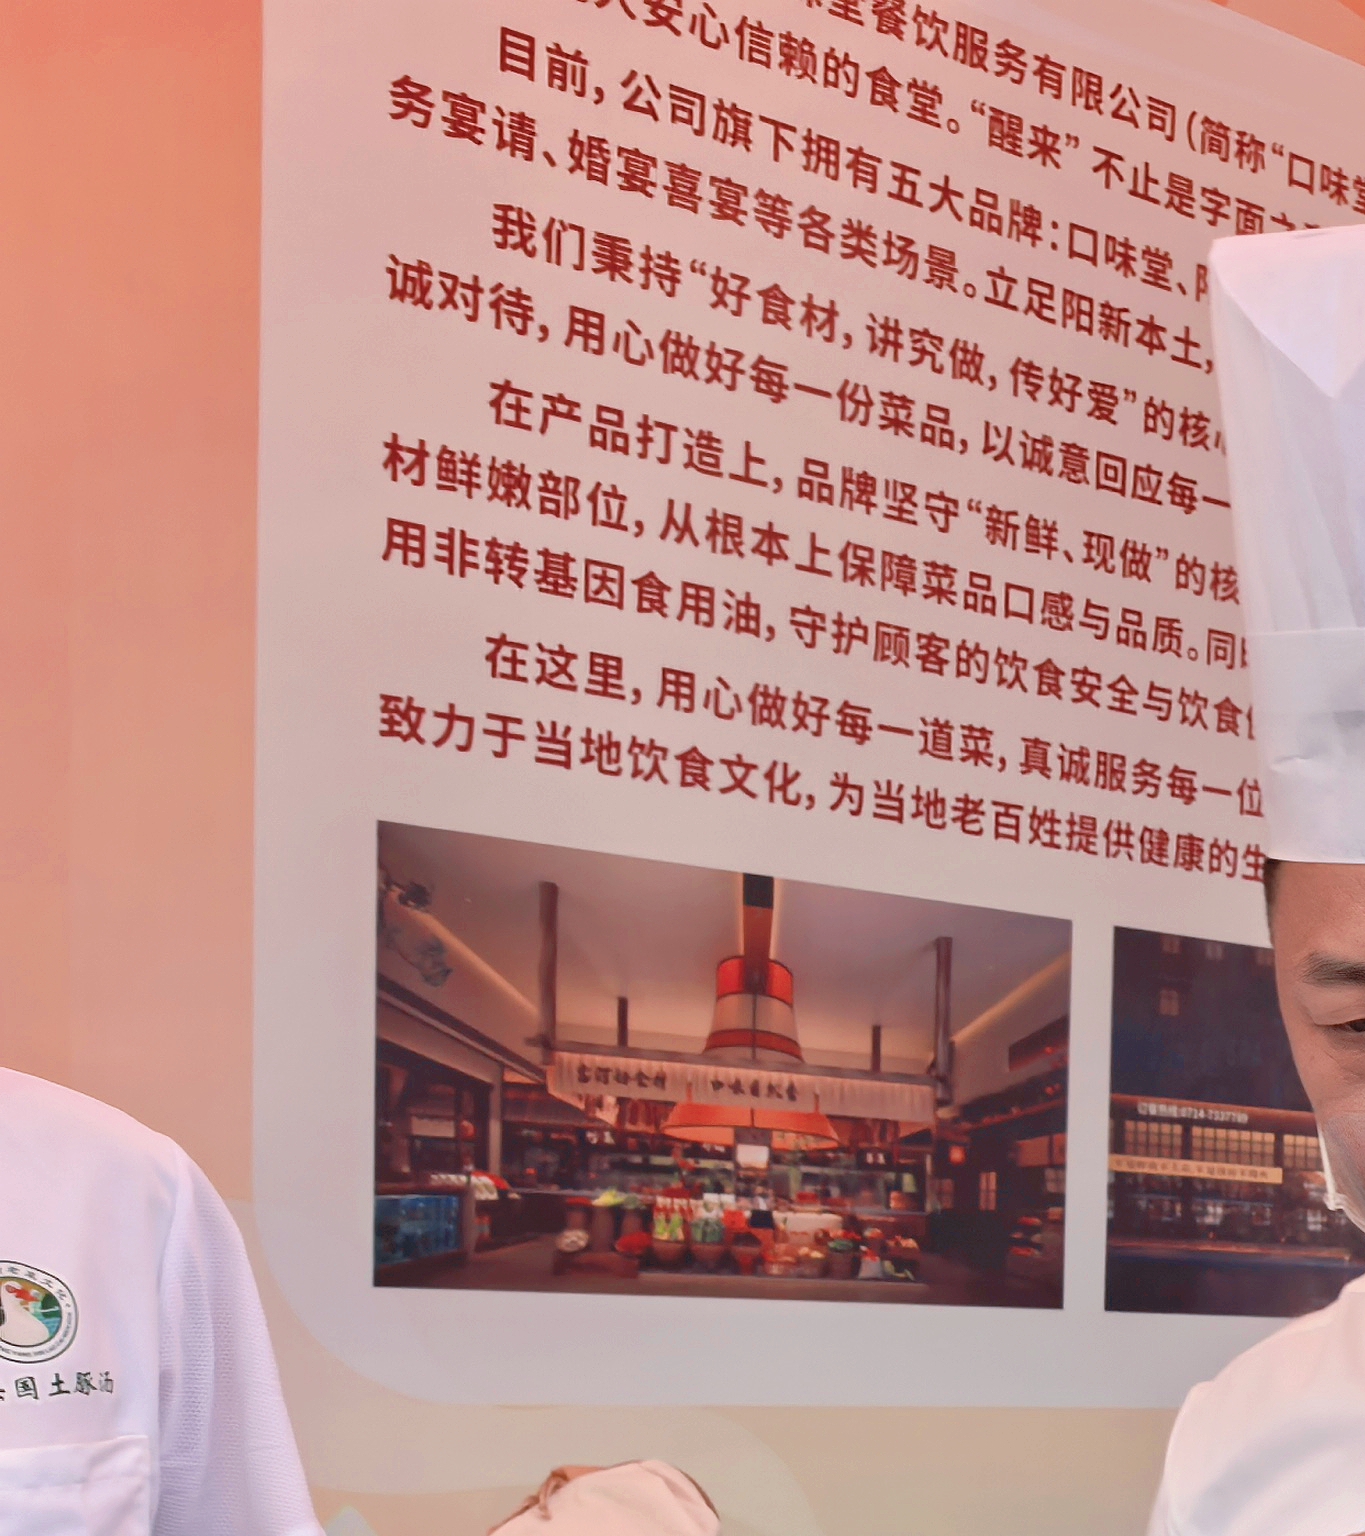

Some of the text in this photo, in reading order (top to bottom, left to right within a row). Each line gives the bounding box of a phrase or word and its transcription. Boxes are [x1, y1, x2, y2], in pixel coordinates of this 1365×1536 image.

[382, 517, 1256, 741] 用非转基因食用油，守护顾客的饮食安全与饮食
